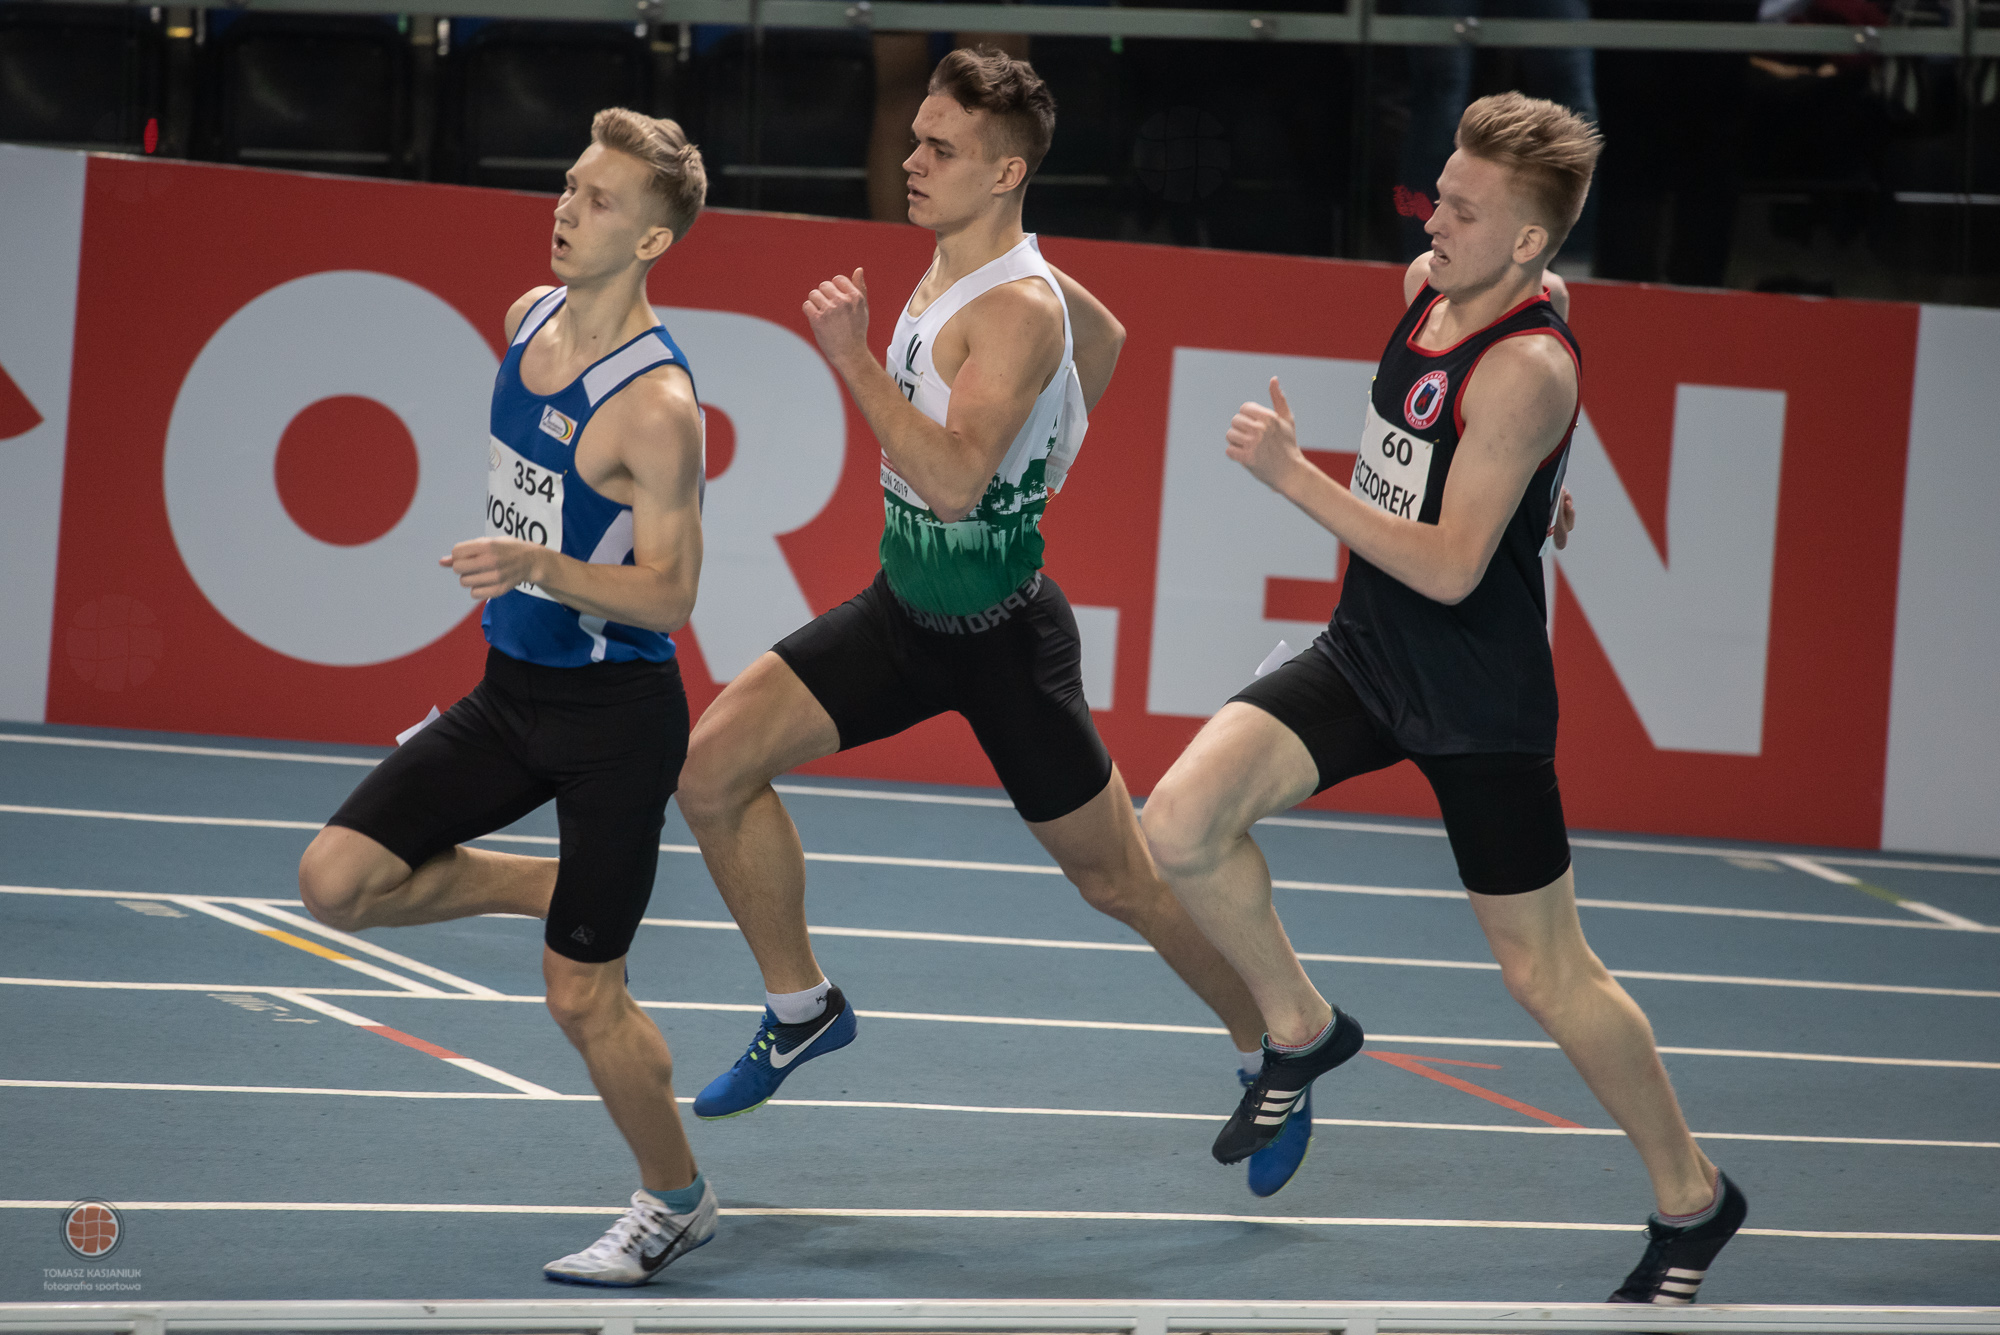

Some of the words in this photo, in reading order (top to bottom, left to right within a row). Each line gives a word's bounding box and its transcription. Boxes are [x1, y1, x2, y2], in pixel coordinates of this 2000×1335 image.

[1382, 431, 1412, 466] 60
[514, 460, 555, 503] 354
[893, 478, 909, 498] 2019
[163, 270, 1786, 757] OREN
